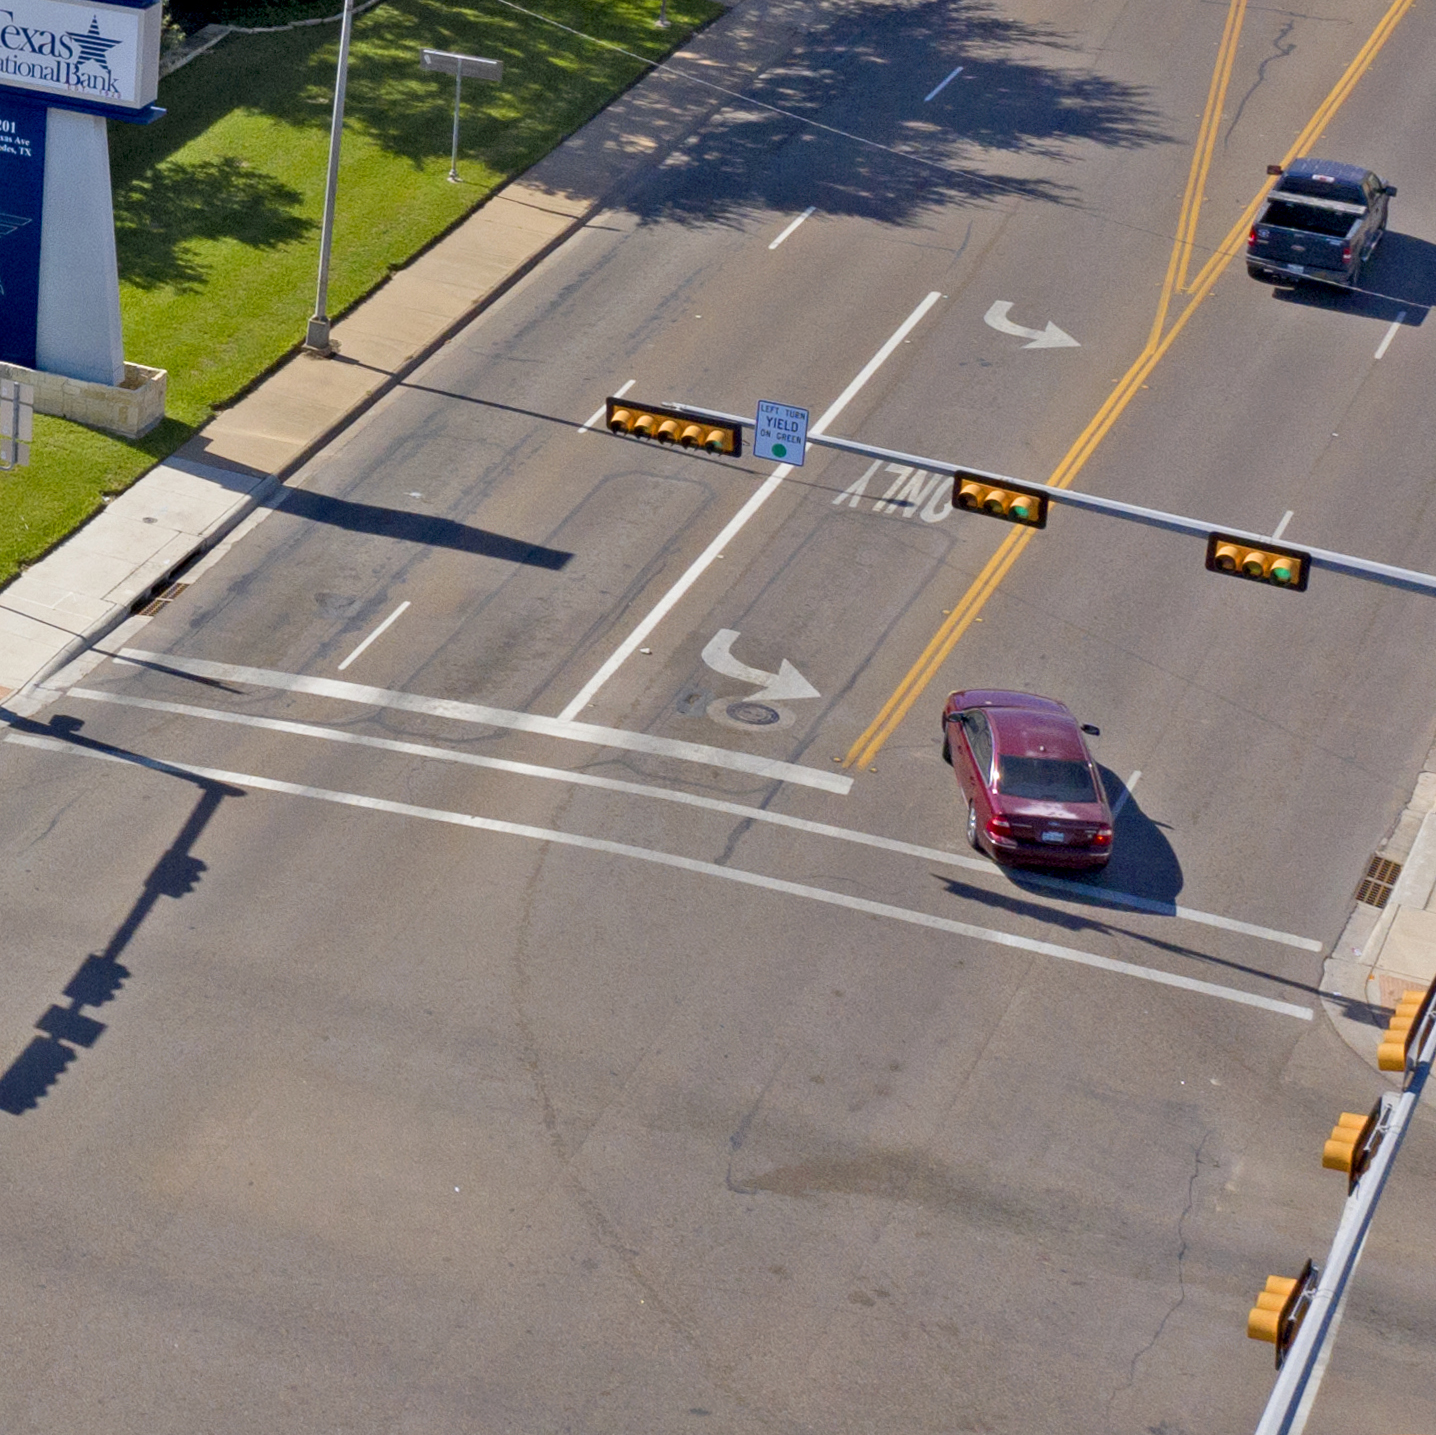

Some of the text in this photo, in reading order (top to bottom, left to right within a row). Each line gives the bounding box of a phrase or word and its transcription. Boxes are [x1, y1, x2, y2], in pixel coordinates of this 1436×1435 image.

[64, 61, 121, 94] Bank
[19, 146, 31, 156] TX
[761, 404, 805, 420] LEFT TURN
[766, 415, 798, 432] YIELD
[760, 429, 801, 444] ON GREEN
